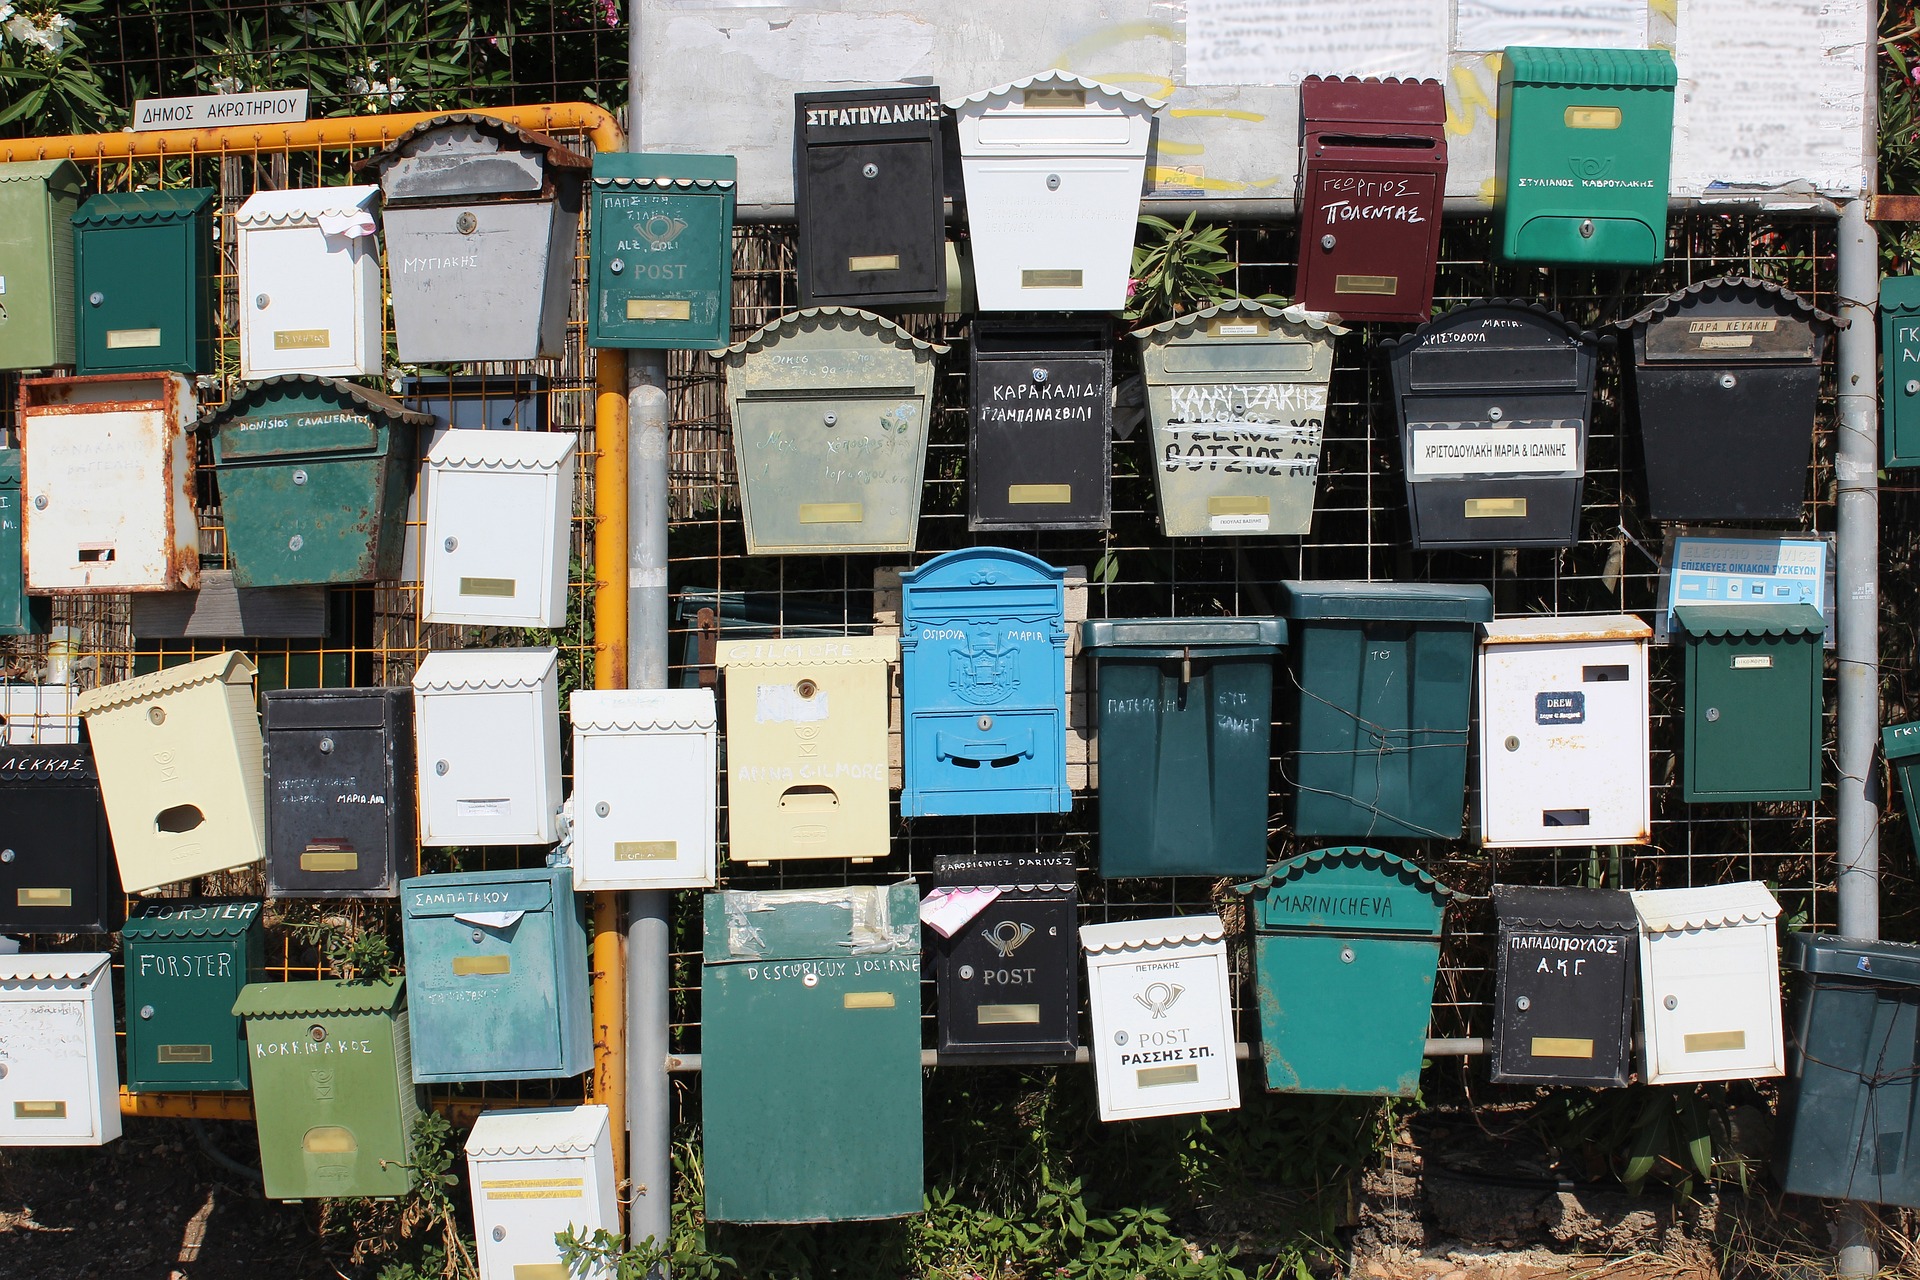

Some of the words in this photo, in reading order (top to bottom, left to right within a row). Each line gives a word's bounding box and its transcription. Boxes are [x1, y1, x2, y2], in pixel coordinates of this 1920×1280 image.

[142, 104, 194, 123] ΔΗΜΟΣ
[207, 98, 298, 118] ΑΚΡΩΤΗΡΙΟΥ
[806, 101, 941, 127] ΣΤΡΑΤΟΥΔΑΚΗΣ
[1323, 177, 1420, 198] ΓΕΩΡΓΙΟΣ
[1518, 178, 1574, 188] ΣΤΥΛΙΑΝΟΣ
[1320, 200, 1426, 225] ΠΟΛΕΝΤΑΣ
[404, 255, 478, 274] ΜΥΓΙΑΚΗΣ
[634, 264, 688, 280] POST
[1494, 444, 1520, 457] ΜΑΡΙΑ
[1522, 444, 1528, 457] &
[1530, 443, 1567, 457] ΙΩΑΝΝΗΣ
[1683, 546, 1750, 560] ELECTRO
[1754, 548, 1817, 562] SERVICE
[1681, 561, 1727, 572] ΕΠΙΣΚΕΥΕΣ
[1729, 563, 1770, 574] ΟΙΚΙΑΚΩΝ
[1772, 564, 1817, 576] ΣΥΣΚΕΥΩΝ
[922, 629, 966, 641] OSIPOVA
[728, 642, 853, 660] GILMORE
[1546, 698, 1573, 708] DREW
[799, 762, 885, 782] GILMORE
[1018, 857, 1073, 867] DARIUSZ
[415, 891, 510, 907] ΣΑΜΠΑΤΑΚΟΥ
[1272, 893, 1394, 919] MARINICHEVA
[140, 902, 259, 920] FORSTER
[1510, 935, 1618, 955] ΠΑΠΑΔΟΠΟΥΛΟΣ
[140, 952, 231, 977] FORSTER
[854, 958, 921, 977] JOSIANE
[1135, 961, 1180, 972] ΠΕΤΡΑΚΗΣ
[983, 968, 1037, 985] POST
[1139, 1028, 1190, 1048] POST
[1121, 1048, 1184, 1066] ΡΑΣΣΗΣ
[1188, 1046, 1215, 1059] ΣΠ.
